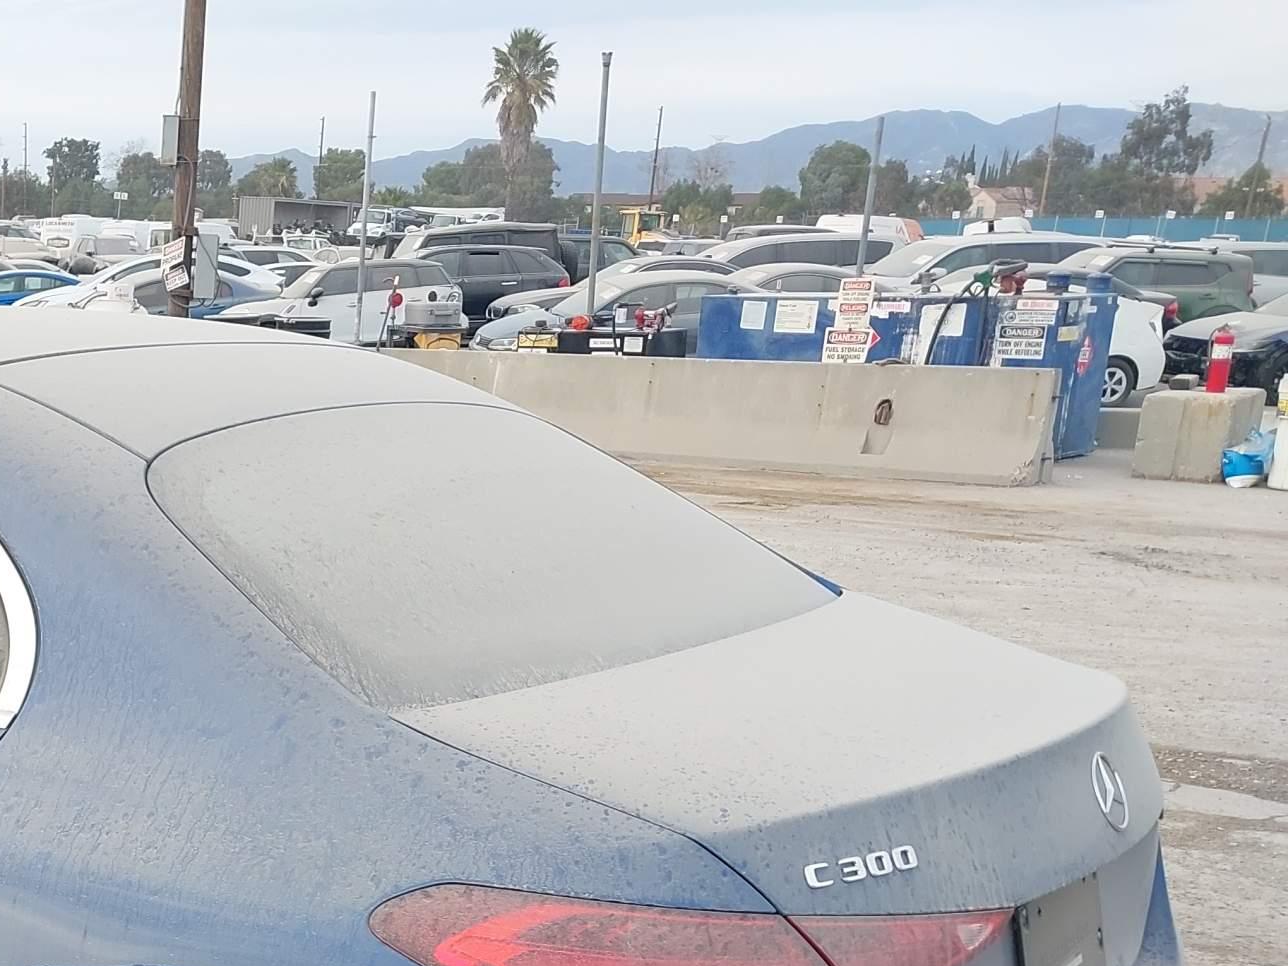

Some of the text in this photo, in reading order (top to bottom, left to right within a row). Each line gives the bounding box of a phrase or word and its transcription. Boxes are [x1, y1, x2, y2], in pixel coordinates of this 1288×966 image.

[831, 332, 866, 343] DANGER
[1006, 328, 1040, 337] DANGER
[804, 845, 919, 889] C 300
